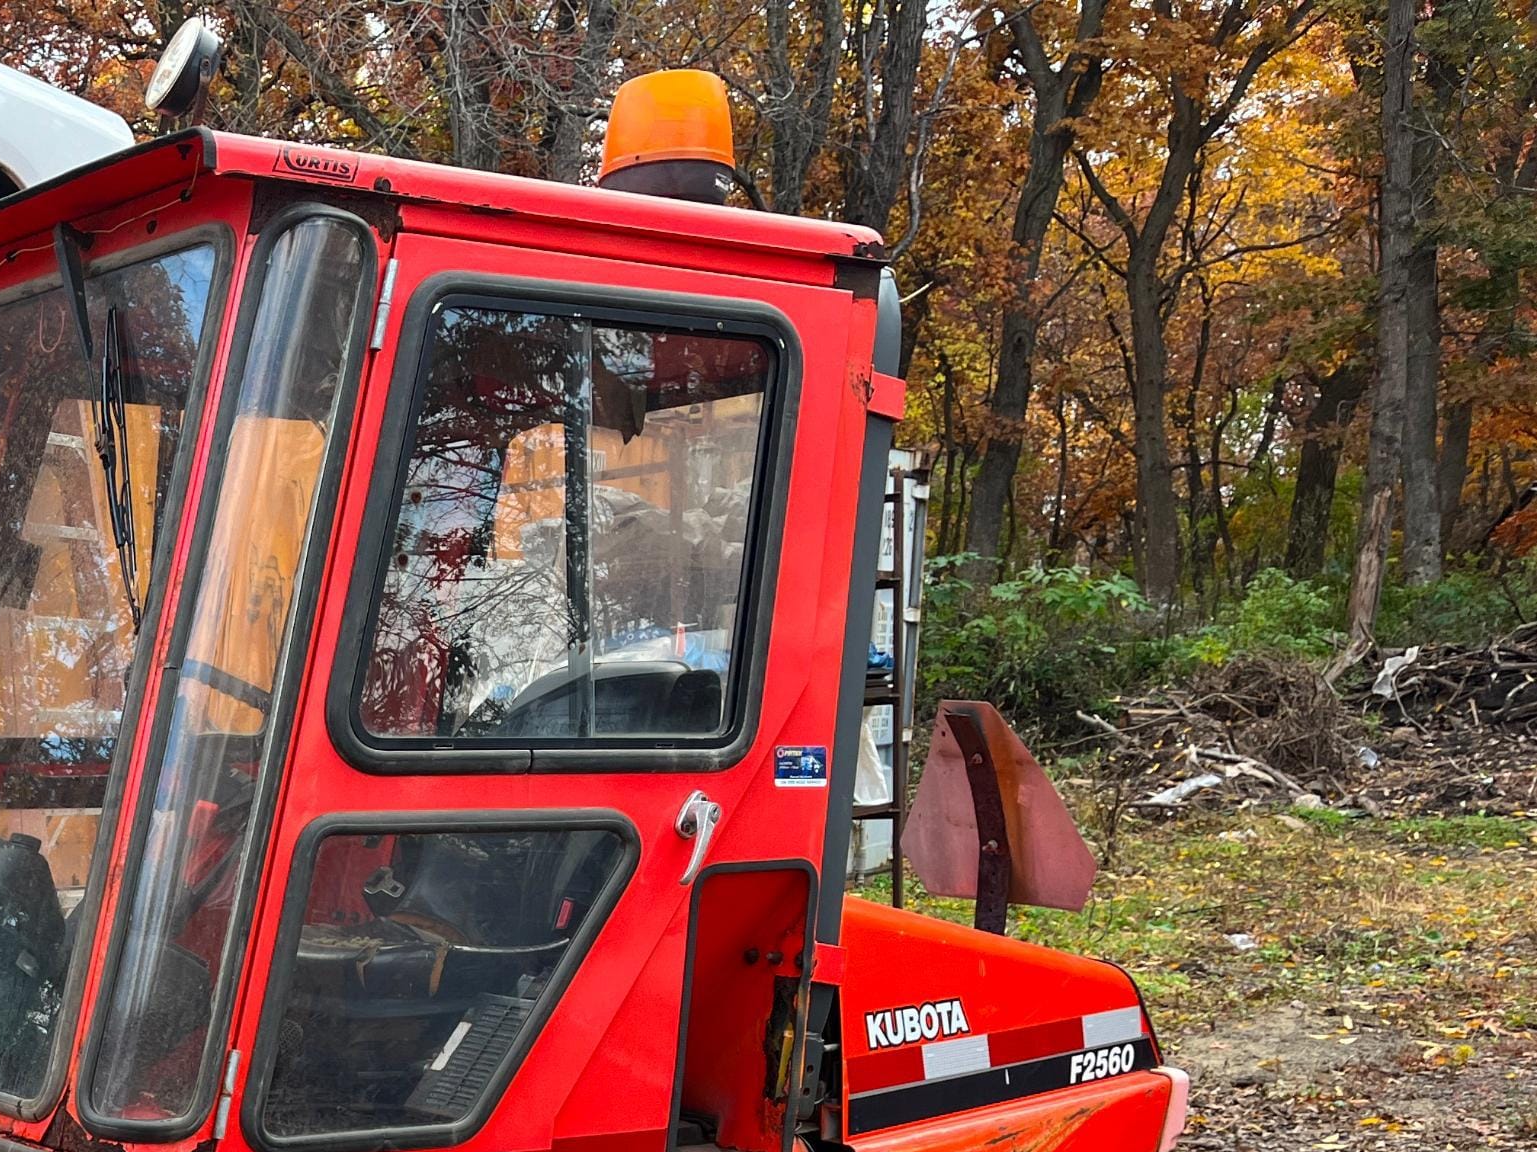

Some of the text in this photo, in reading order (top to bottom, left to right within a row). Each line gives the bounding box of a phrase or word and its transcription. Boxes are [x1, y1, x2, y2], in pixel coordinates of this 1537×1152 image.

[283, 145, 351, 179] CURTIS
[866, 1000, 969, 1049] KUBOTA
[1070, 1043, 1135, 1085] F2560
